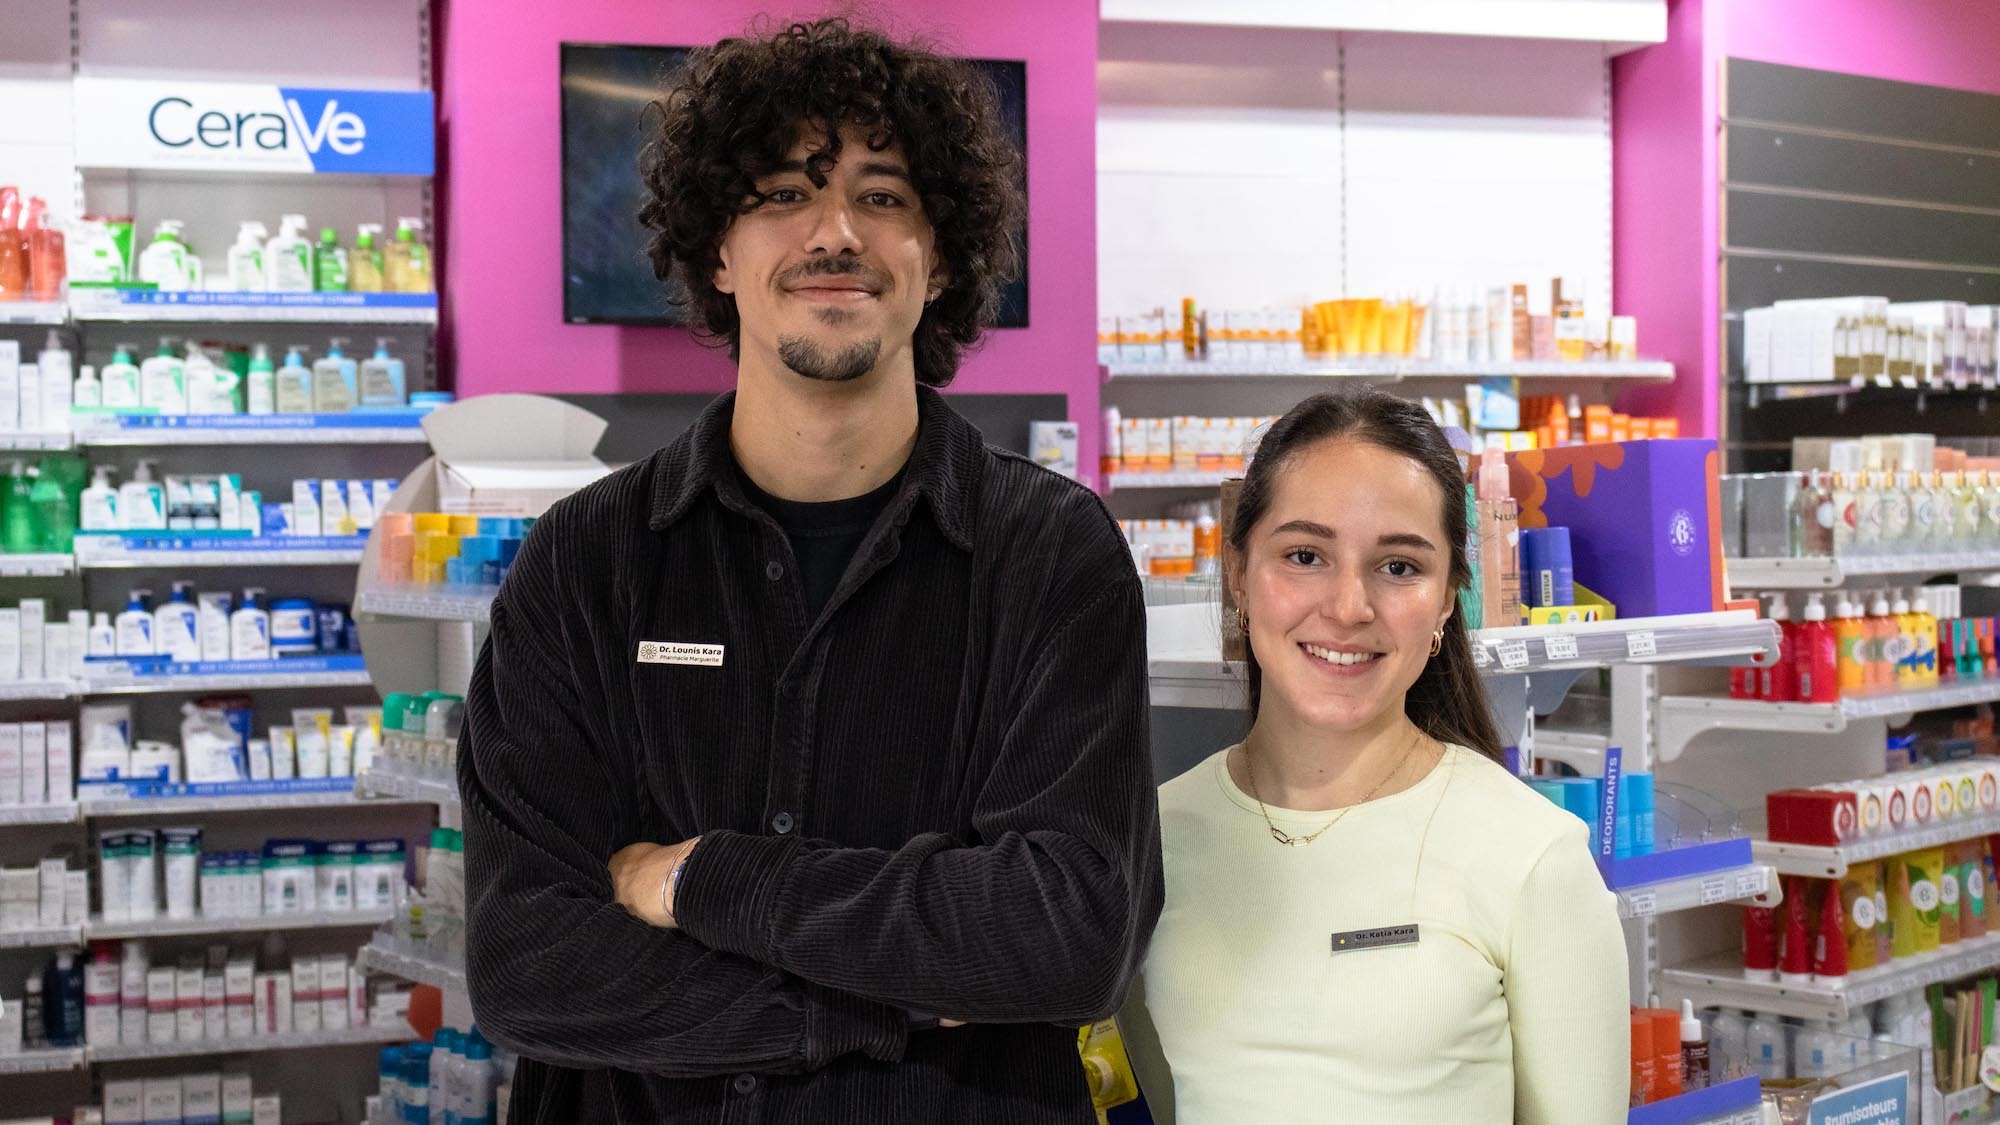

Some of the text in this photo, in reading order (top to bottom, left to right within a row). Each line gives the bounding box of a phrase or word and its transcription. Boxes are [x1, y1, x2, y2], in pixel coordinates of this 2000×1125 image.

[148, 96, 366, 155] CeraVe
[1543, 573, 1551, 603] TESTEUR
[672, 646, 701, 654] Lounis
[1602, 757, 1618, 855] DÉODORANTS
[1369, 930, 1392, 938] Katia
